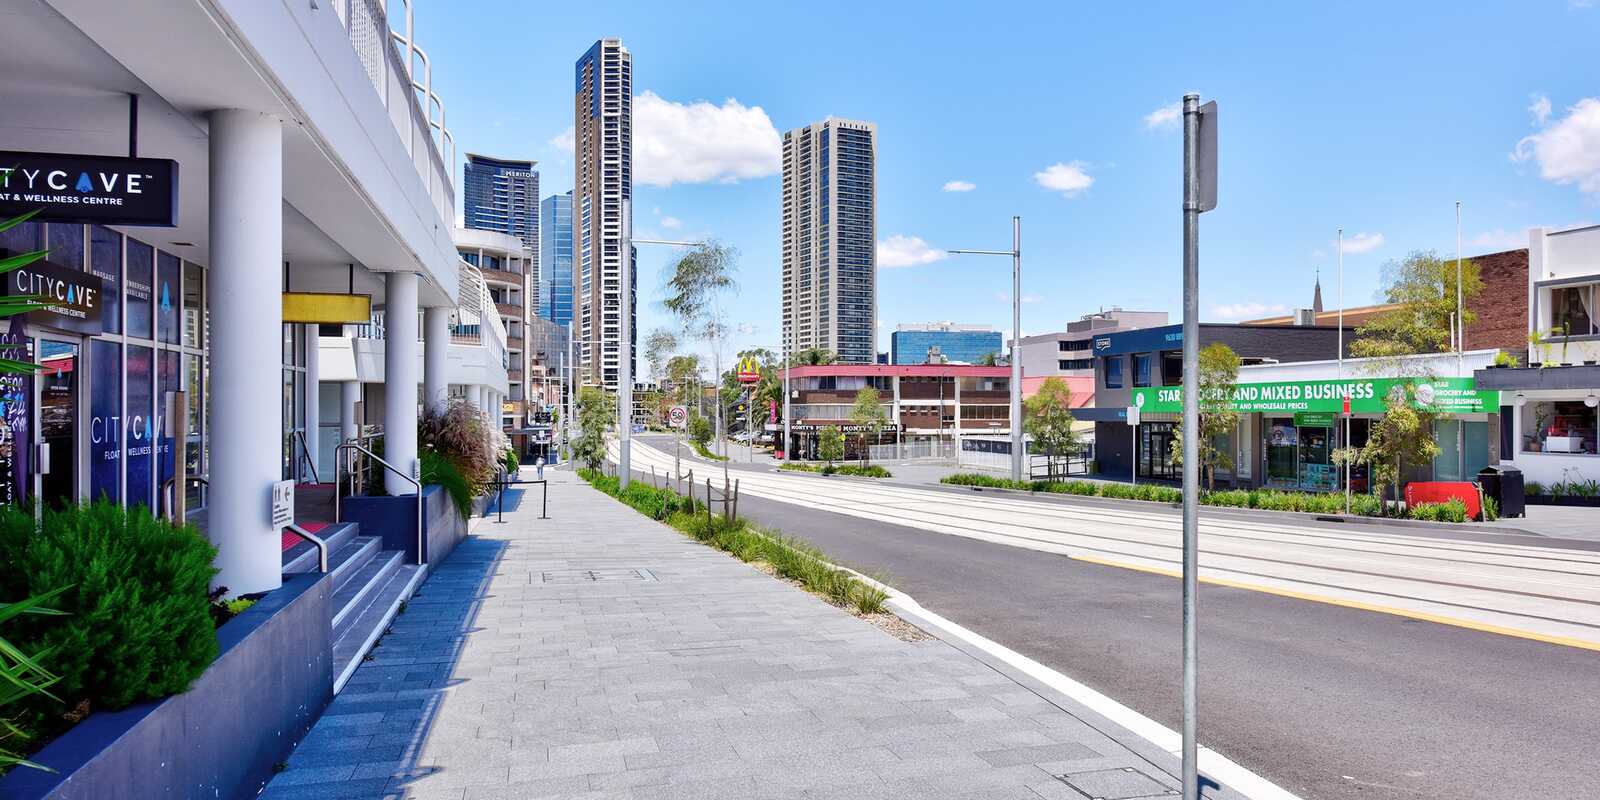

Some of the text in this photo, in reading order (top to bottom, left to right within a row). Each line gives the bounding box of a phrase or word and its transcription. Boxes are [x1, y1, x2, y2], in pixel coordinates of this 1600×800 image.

[13, 193, 21, 201] &
[24, 194, 79, 204] WELLNESS
[82, 196, 123, 206] CENTRE
[16, 269, 93, 308] CITYCAVE
[1158, 389, 1181, 402] STAR
[1232, 386, 1258, 401] AND
[1260, 384, 1301, 400] MIXED
[1304, 382, 1374, 400] BUSINESS
[1239, 402, 1252, 410] AND
[1253, 401, 1286, 410] WHOLESALE
[1287, 400, 1308, 410] PRICES
[672, 411, 683, 420] 50
[104, 449, 120, 461] FLOAT
